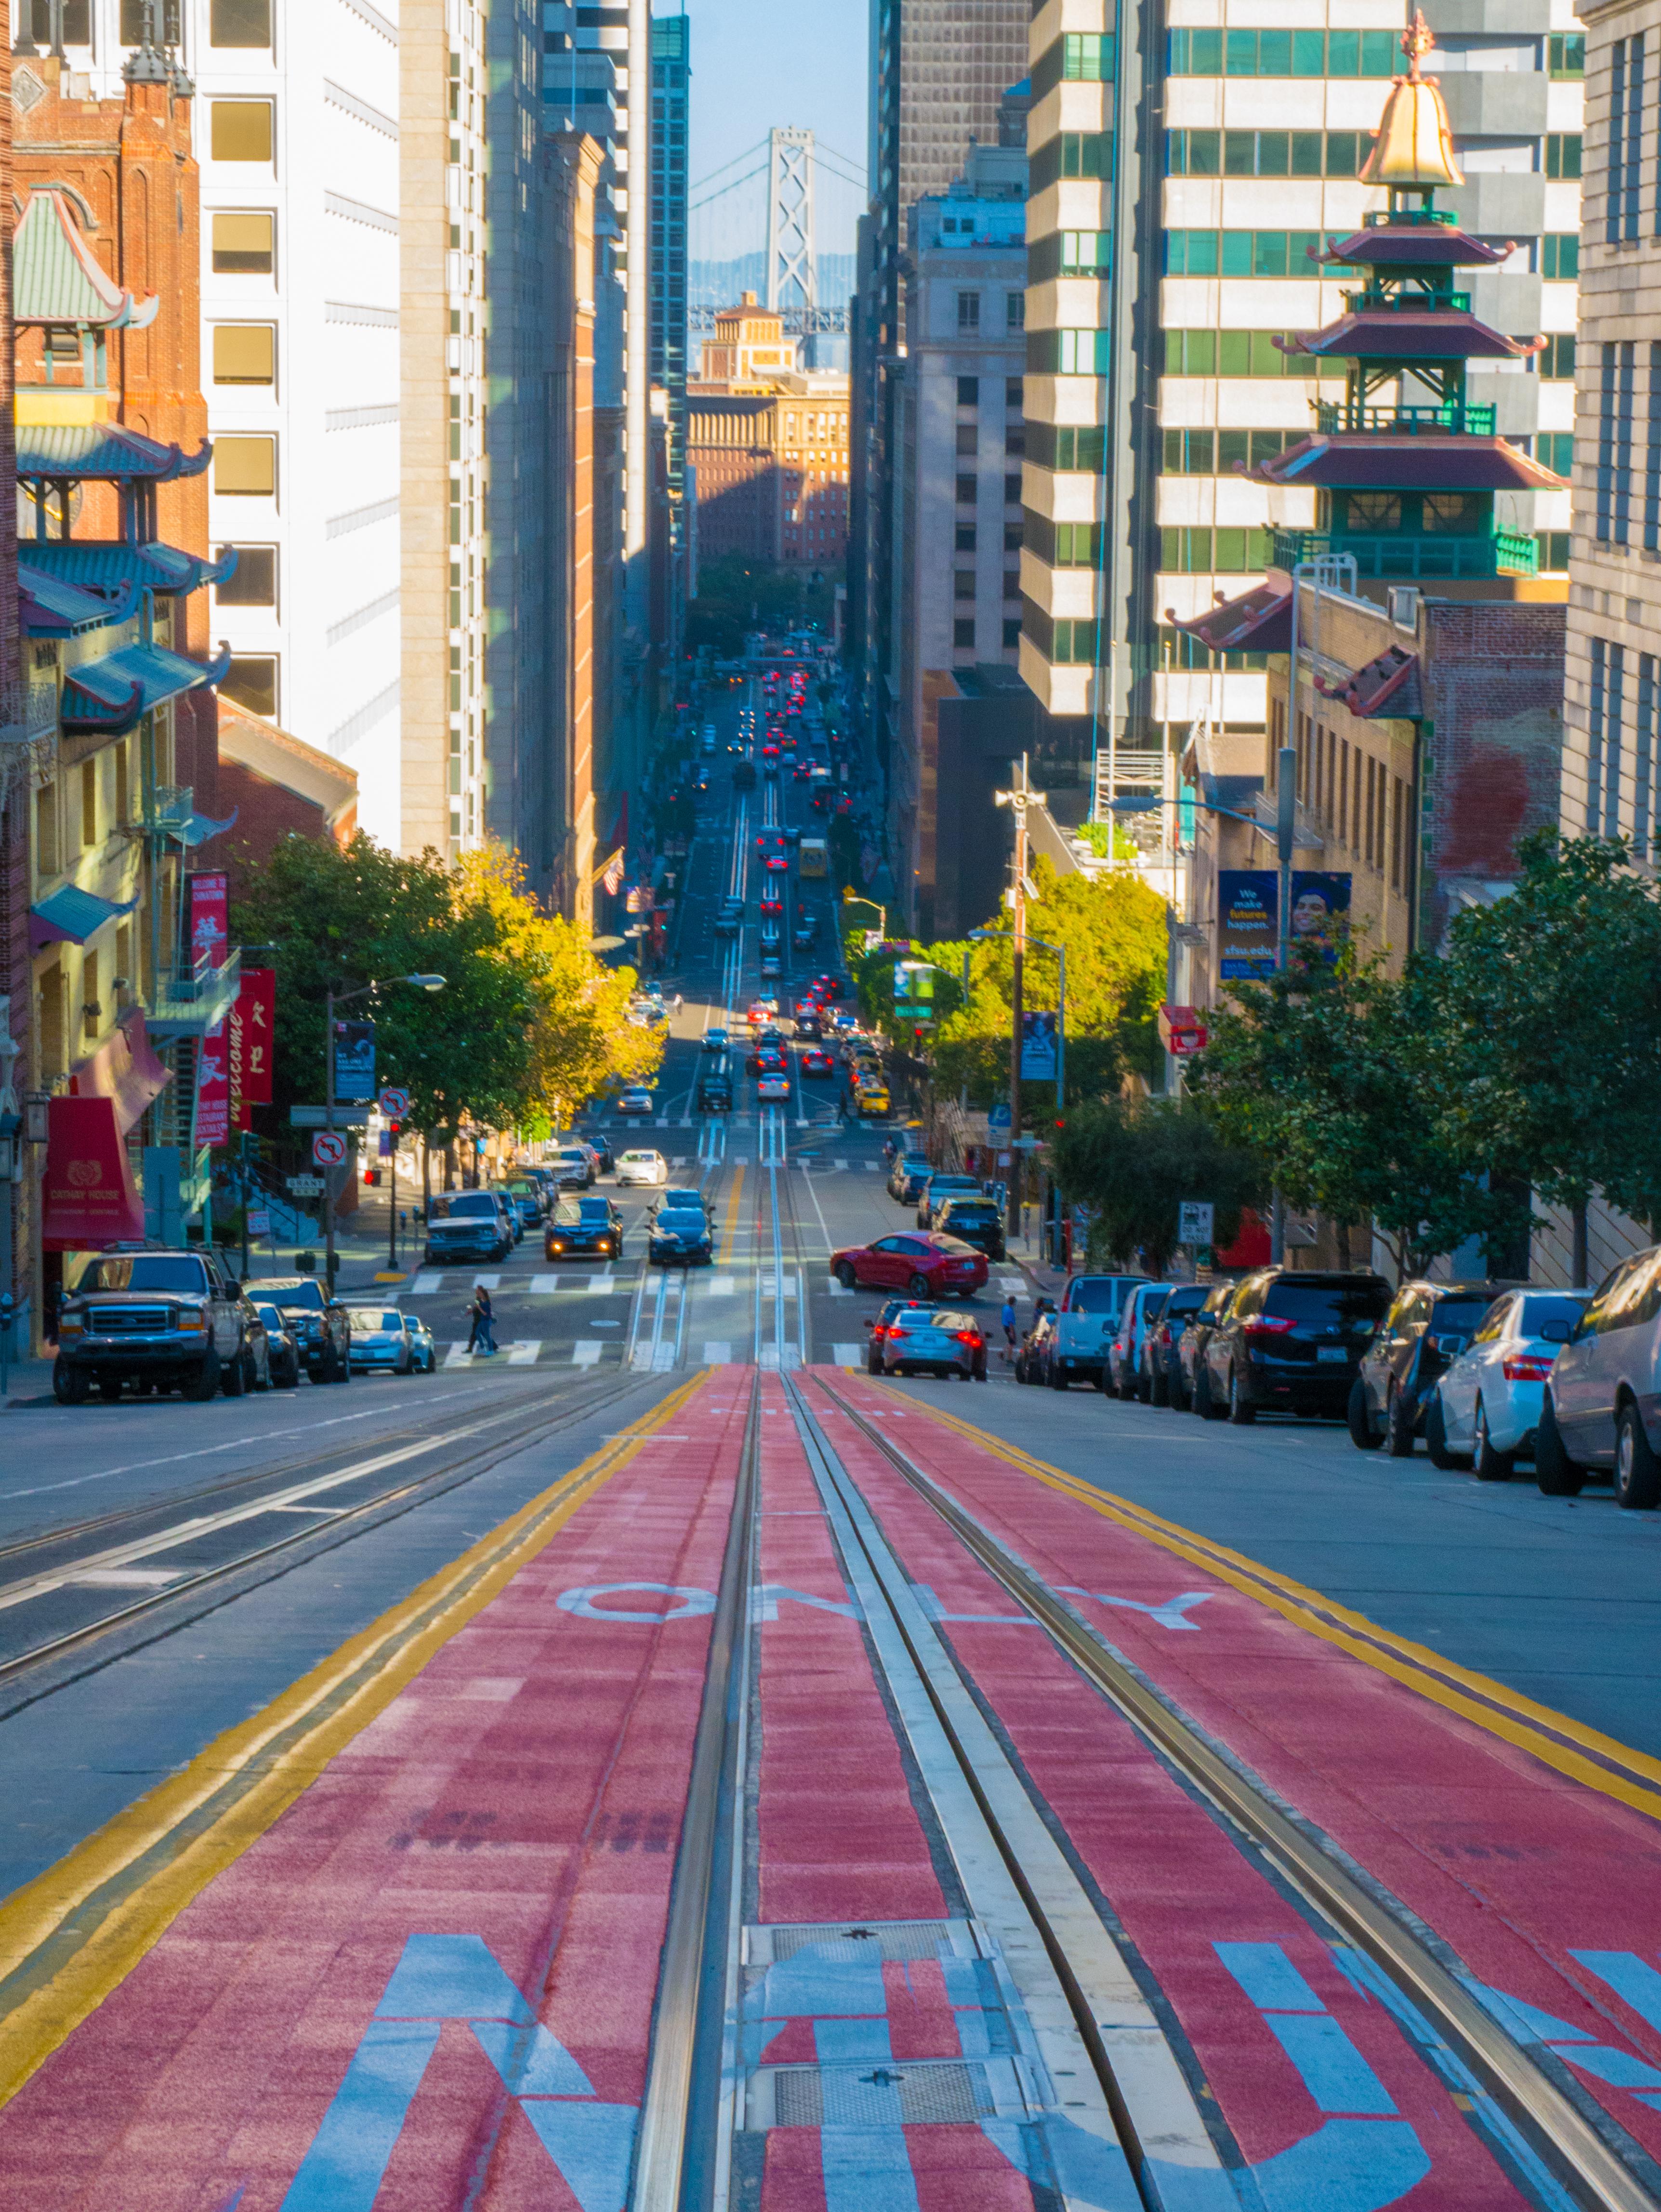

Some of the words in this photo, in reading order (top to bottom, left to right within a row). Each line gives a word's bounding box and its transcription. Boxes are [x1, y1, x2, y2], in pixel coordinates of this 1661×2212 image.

[1239, 889, 1257, 899] We
[1234, 899, 1262, 909] make
[1230, 909, 1267, 919] futures
[1227, 919, 1269, 931] happen.
[1225, 944, 1273, 956] sfsu.edu
[87, 1189, 119, 1199] HOUSE
[555, 1580, 1216, 1631] ONLY
